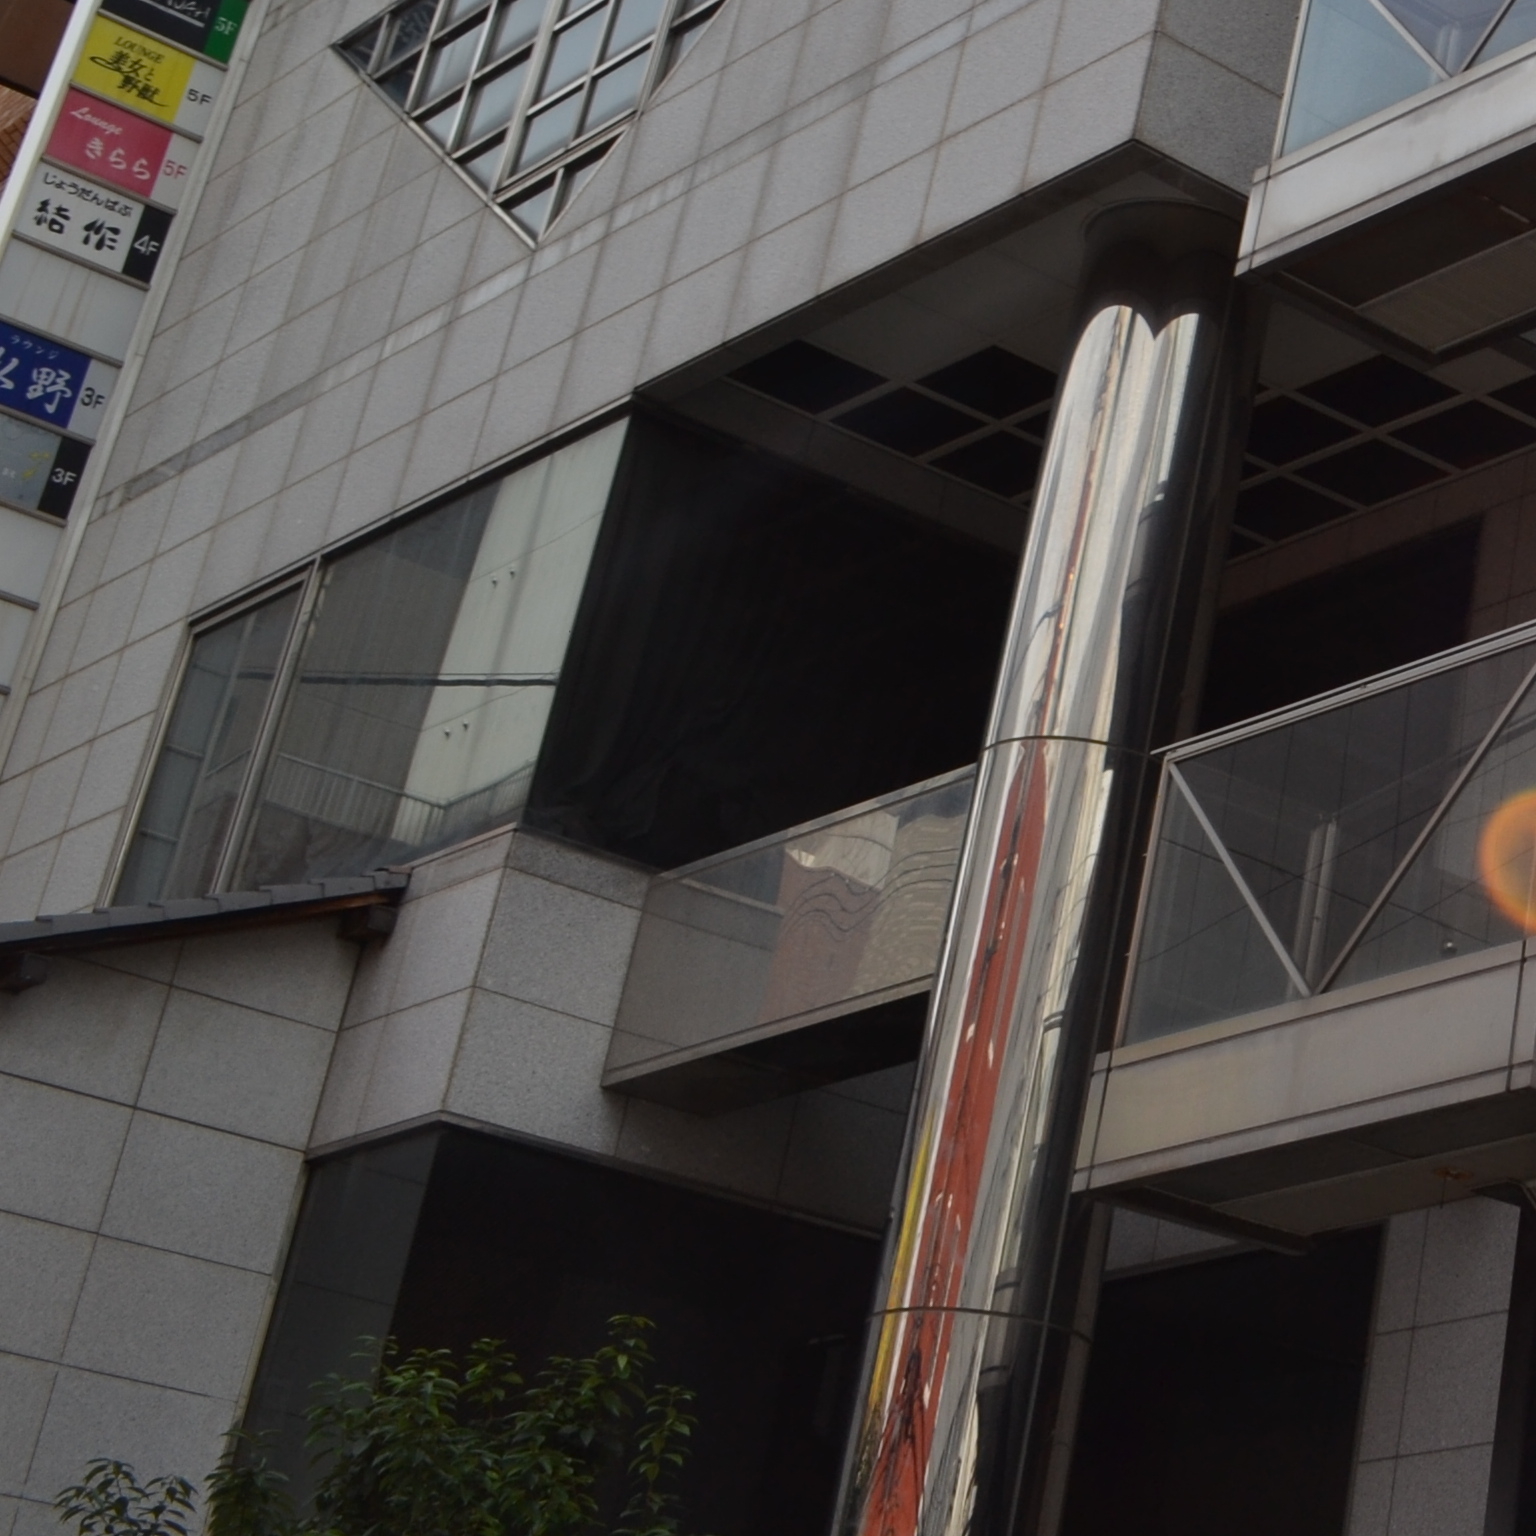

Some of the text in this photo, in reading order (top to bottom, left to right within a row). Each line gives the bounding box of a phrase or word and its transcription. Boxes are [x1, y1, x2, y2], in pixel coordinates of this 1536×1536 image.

[214, 17, 238, 36] 5F
[114, 36, 165, 64] LOUNGE
[186, 88, 213, 106] 5F
[70, 107, 123, 135] Lounge
[84, 137, 150, 180] きらら
[163, 160, 187, 180] 5F
[133, 235, 160, 256] 4F
[10, 334, 60, 359] ラウンジ
[81, 387, 106, 409] 3F
[52, 467, 78, 486] 3F
